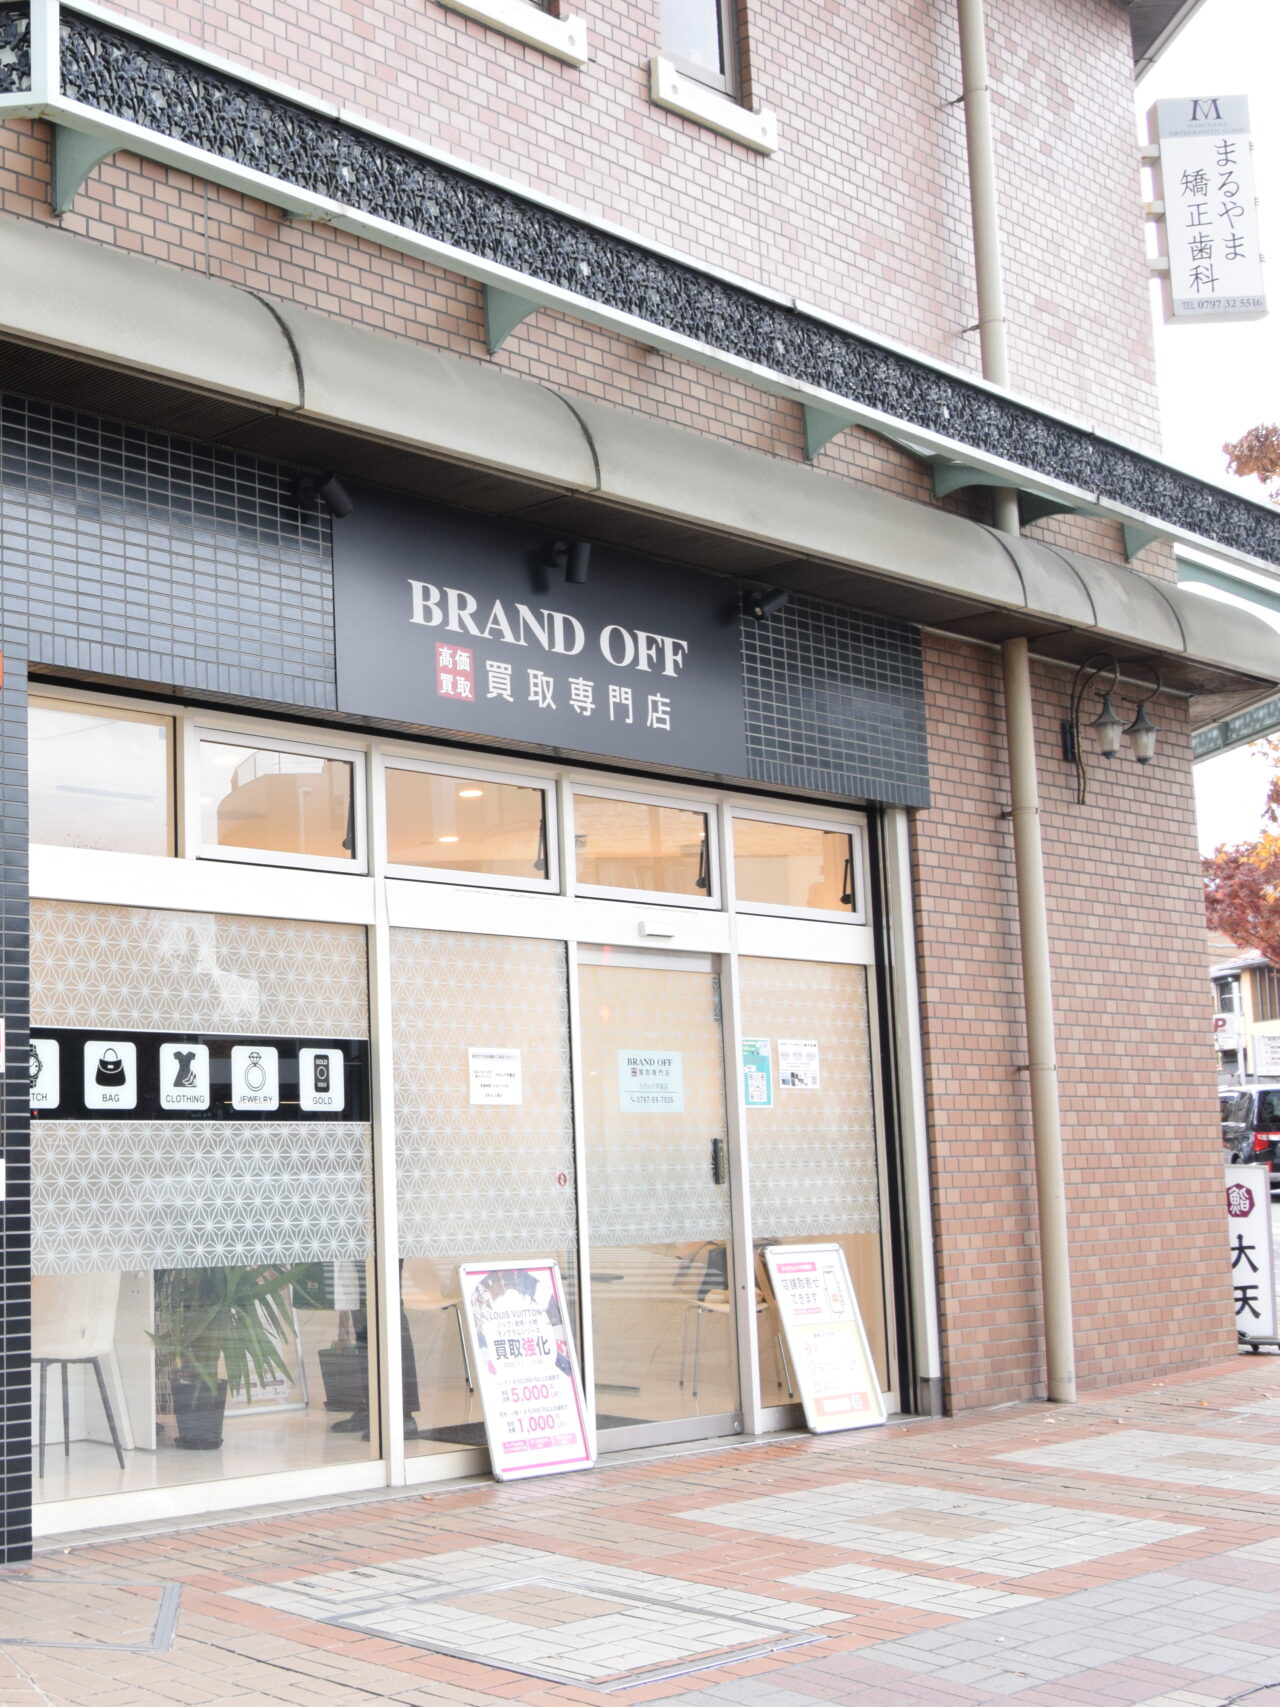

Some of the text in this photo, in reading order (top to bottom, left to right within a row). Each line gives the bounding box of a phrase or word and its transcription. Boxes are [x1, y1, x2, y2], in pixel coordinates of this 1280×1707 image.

[1190, 98, 1224, 121] M
[1214, 138, 1246, 261] まるやま
[1180, 168, 1219, 294] 矯正歯科
[1181, 301, 1196, 310] TEL
[1197, 299, 1222, 310] 0797
[407, 579, 688, 678] BRAND OFF
[438, 646, 470, 672] 高価
[439, 673, 472, 699] 買取
[485, 659, 671, 731] 買取専門店
[1214, 1017, 1227, 1033] P
[626, 1057, 673, 1067] BRAND OFF
[31, 1092, 48, 1102] TCH
[102, 1093, 120, 1103] BAG
[165, 1094, 205, 1104] CLOTHING
[238, 1095, 273, 1105] JEWELRY
[312, 1096, 333, 1105] GOLD
[1230, 1234, 1261, 1319] 大天
[489, 1308, 542, 1321] LOUIS VUITTON
[493, 1335, 551, 1361] 買取強化
